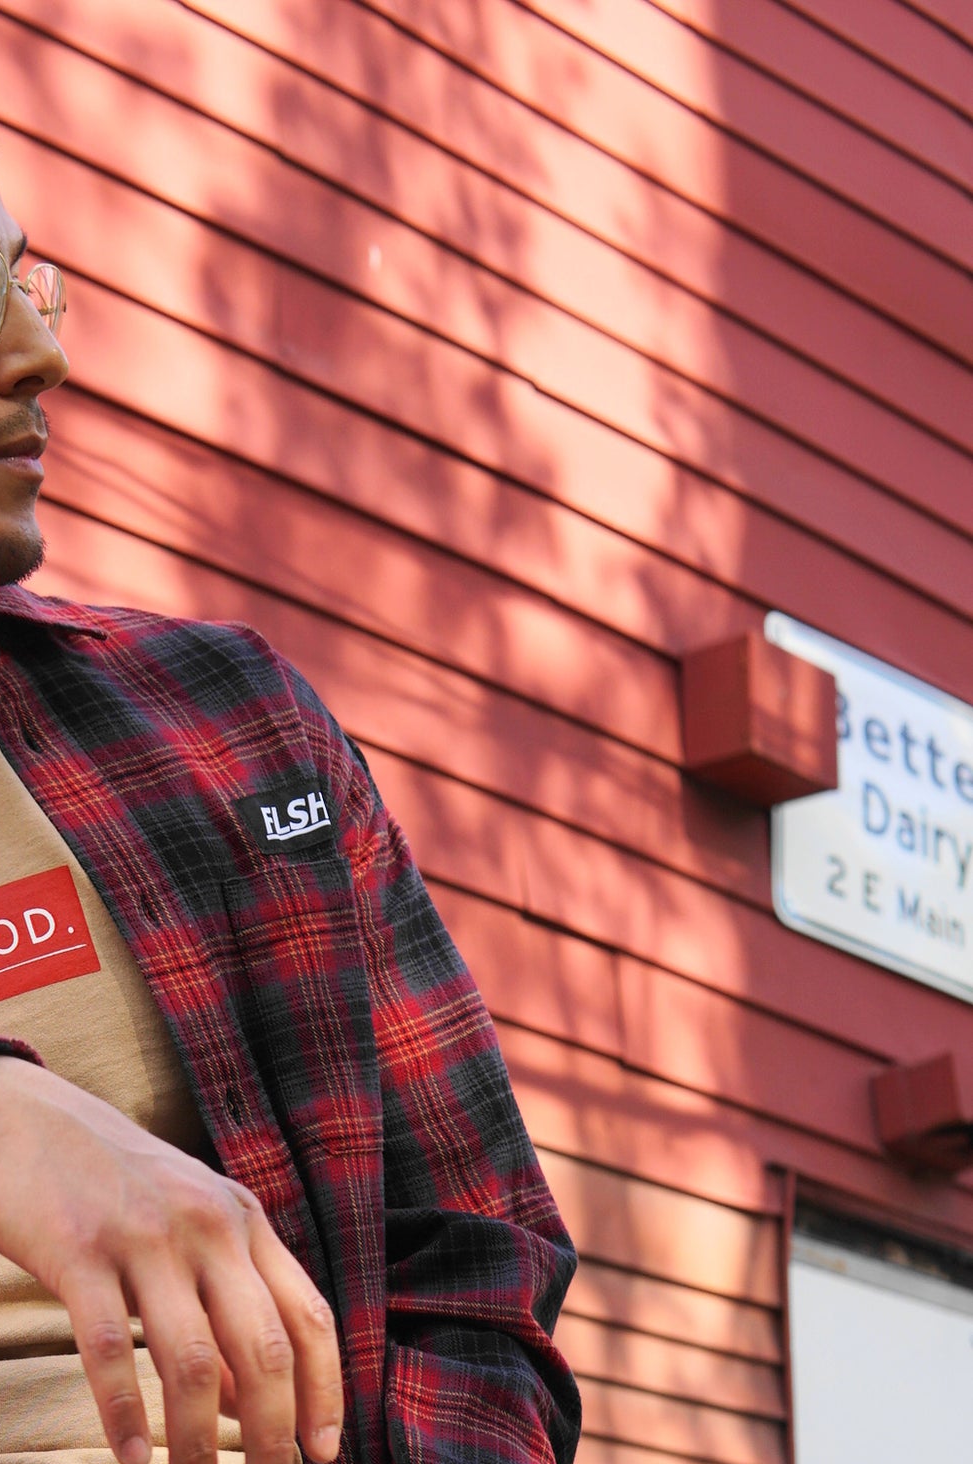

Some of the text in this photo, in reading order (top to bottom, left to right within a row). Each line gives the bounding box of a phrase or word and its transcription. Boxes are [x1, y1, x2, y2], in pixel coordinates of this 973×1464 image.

[863, 780, 973, 890] Dairy
[827, 854, 846, 898] 2
[863, 870, 881, 914] E
